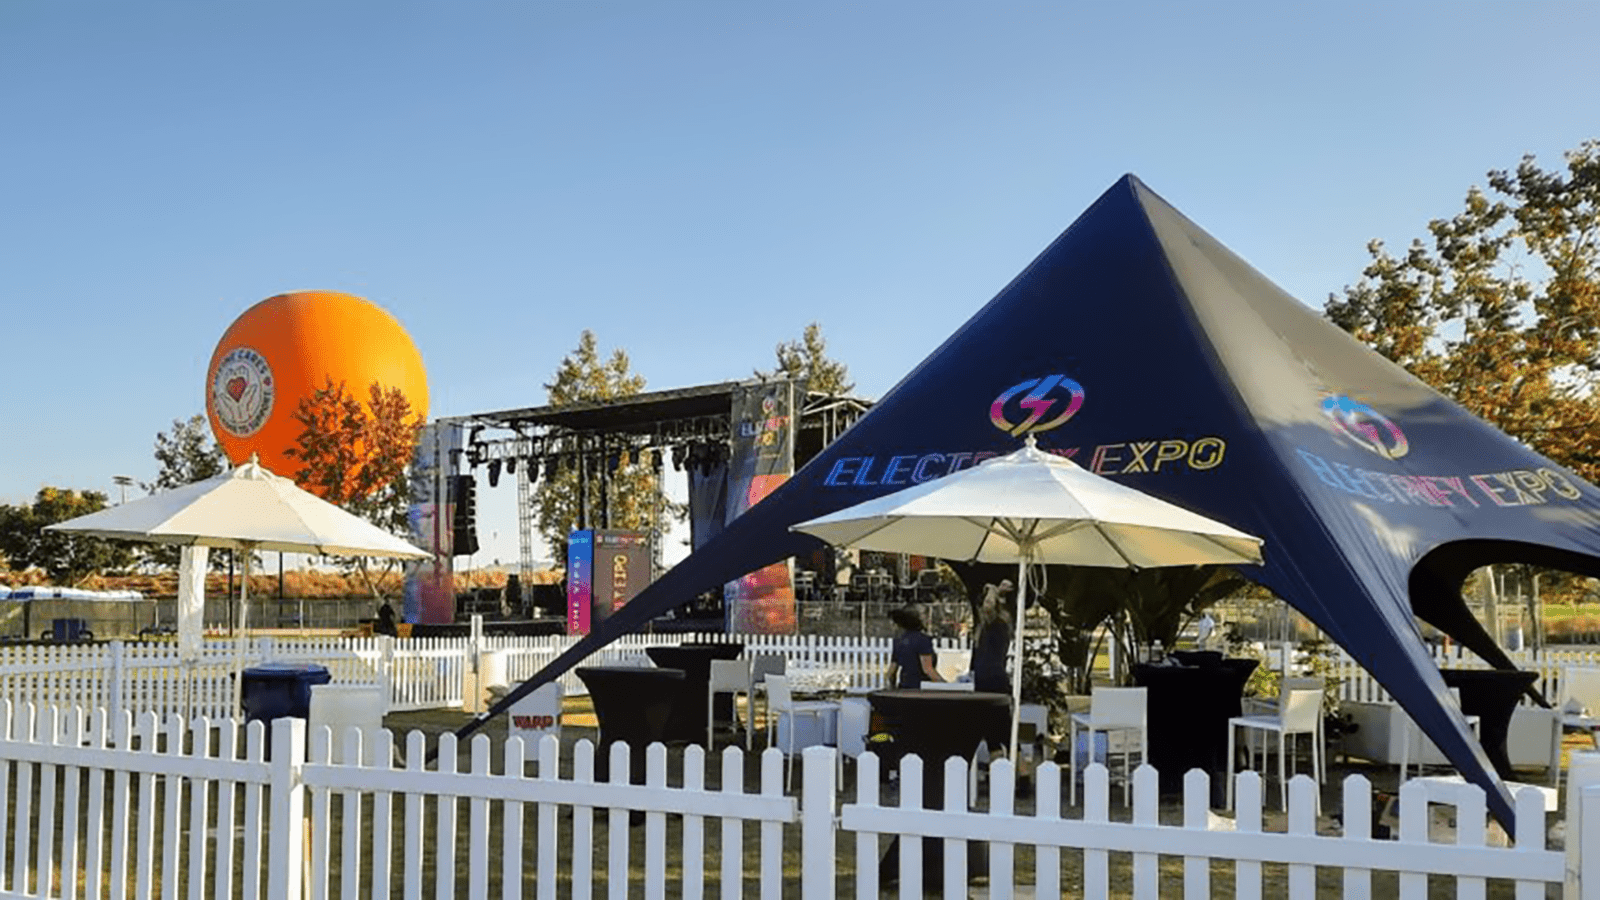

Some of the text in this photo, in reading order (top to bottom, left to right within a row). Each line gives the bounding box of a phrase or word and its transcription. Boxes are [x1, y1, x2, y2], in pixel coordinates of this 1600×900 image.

[824, 437, 1226, 486] ELECT EXPO
[1296, 446, 1581, 507] ELECTRIFY EXPO
